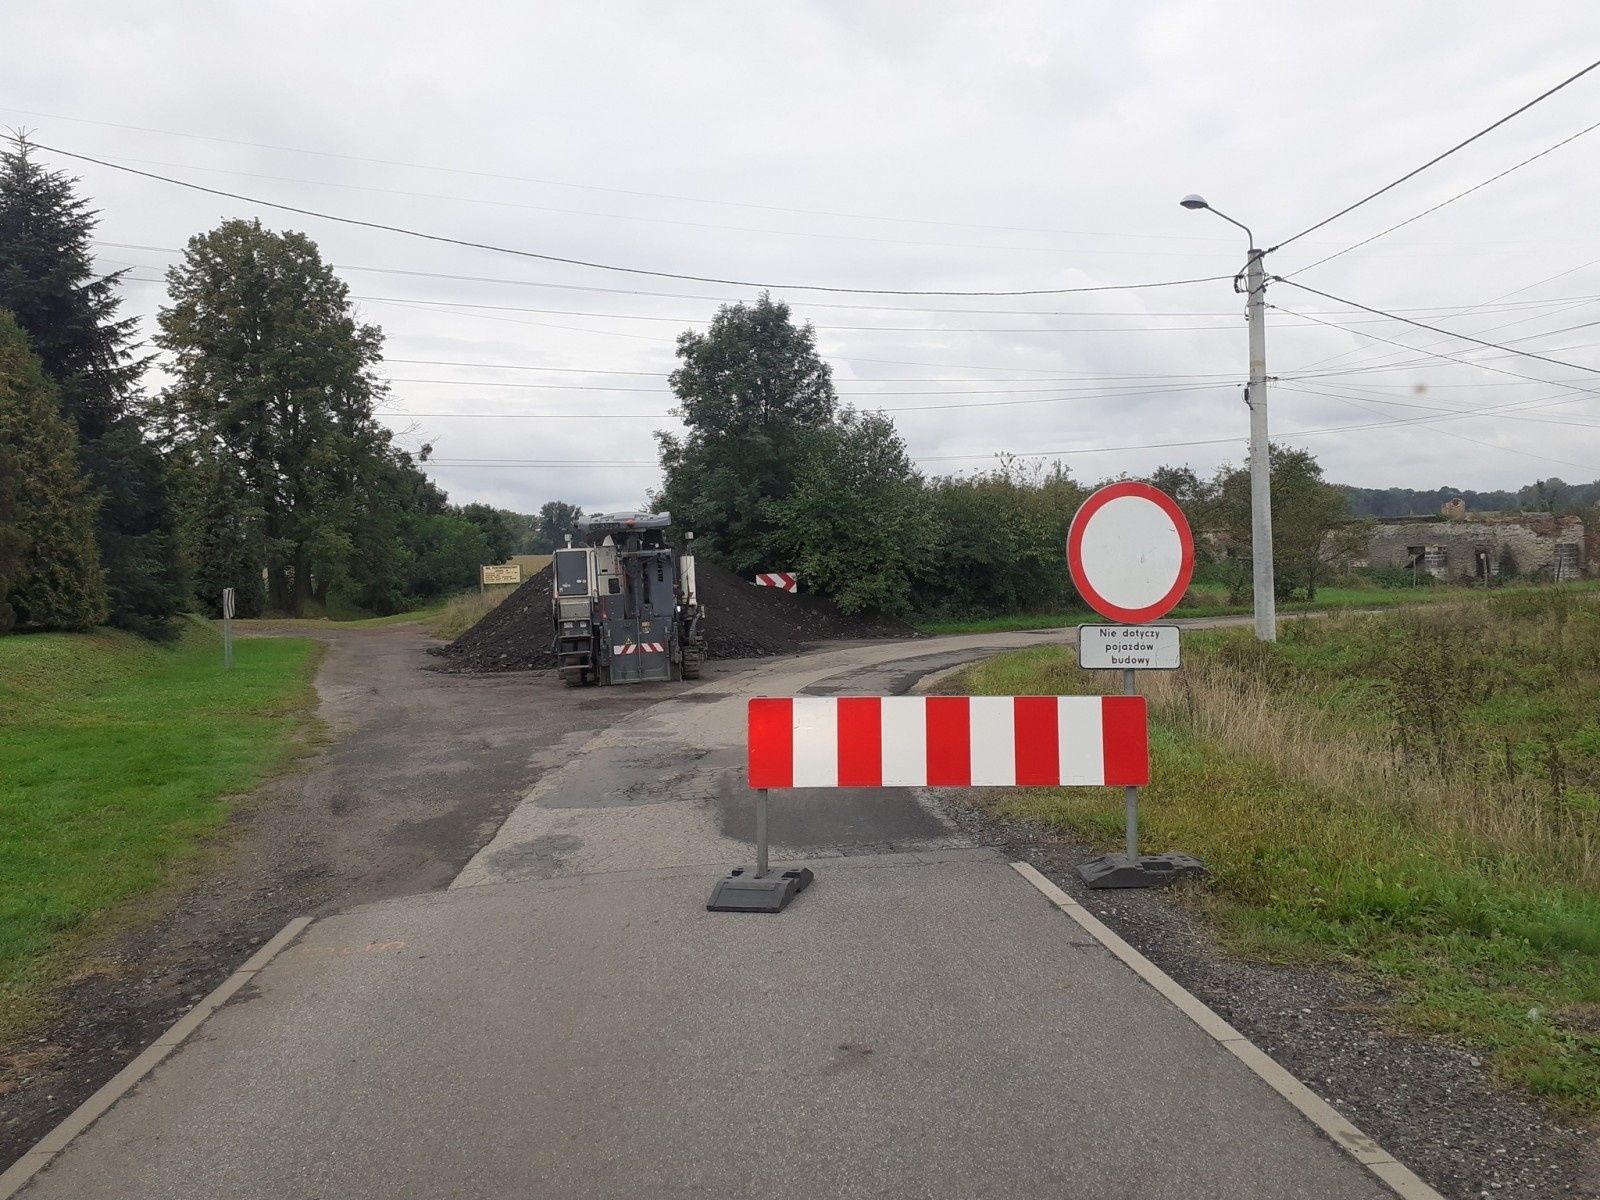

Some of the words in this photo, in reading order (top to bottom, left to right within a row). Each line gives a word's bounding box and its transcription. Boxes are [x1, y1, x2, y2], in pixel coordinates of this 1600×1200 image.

[1099, 628, 1117, 637] Nie
[1122, 628, 1160, 640] dotyczy
[1105, 641, 1154, 653] pojazdów
[1111, 655, 1150, 666] budowy
